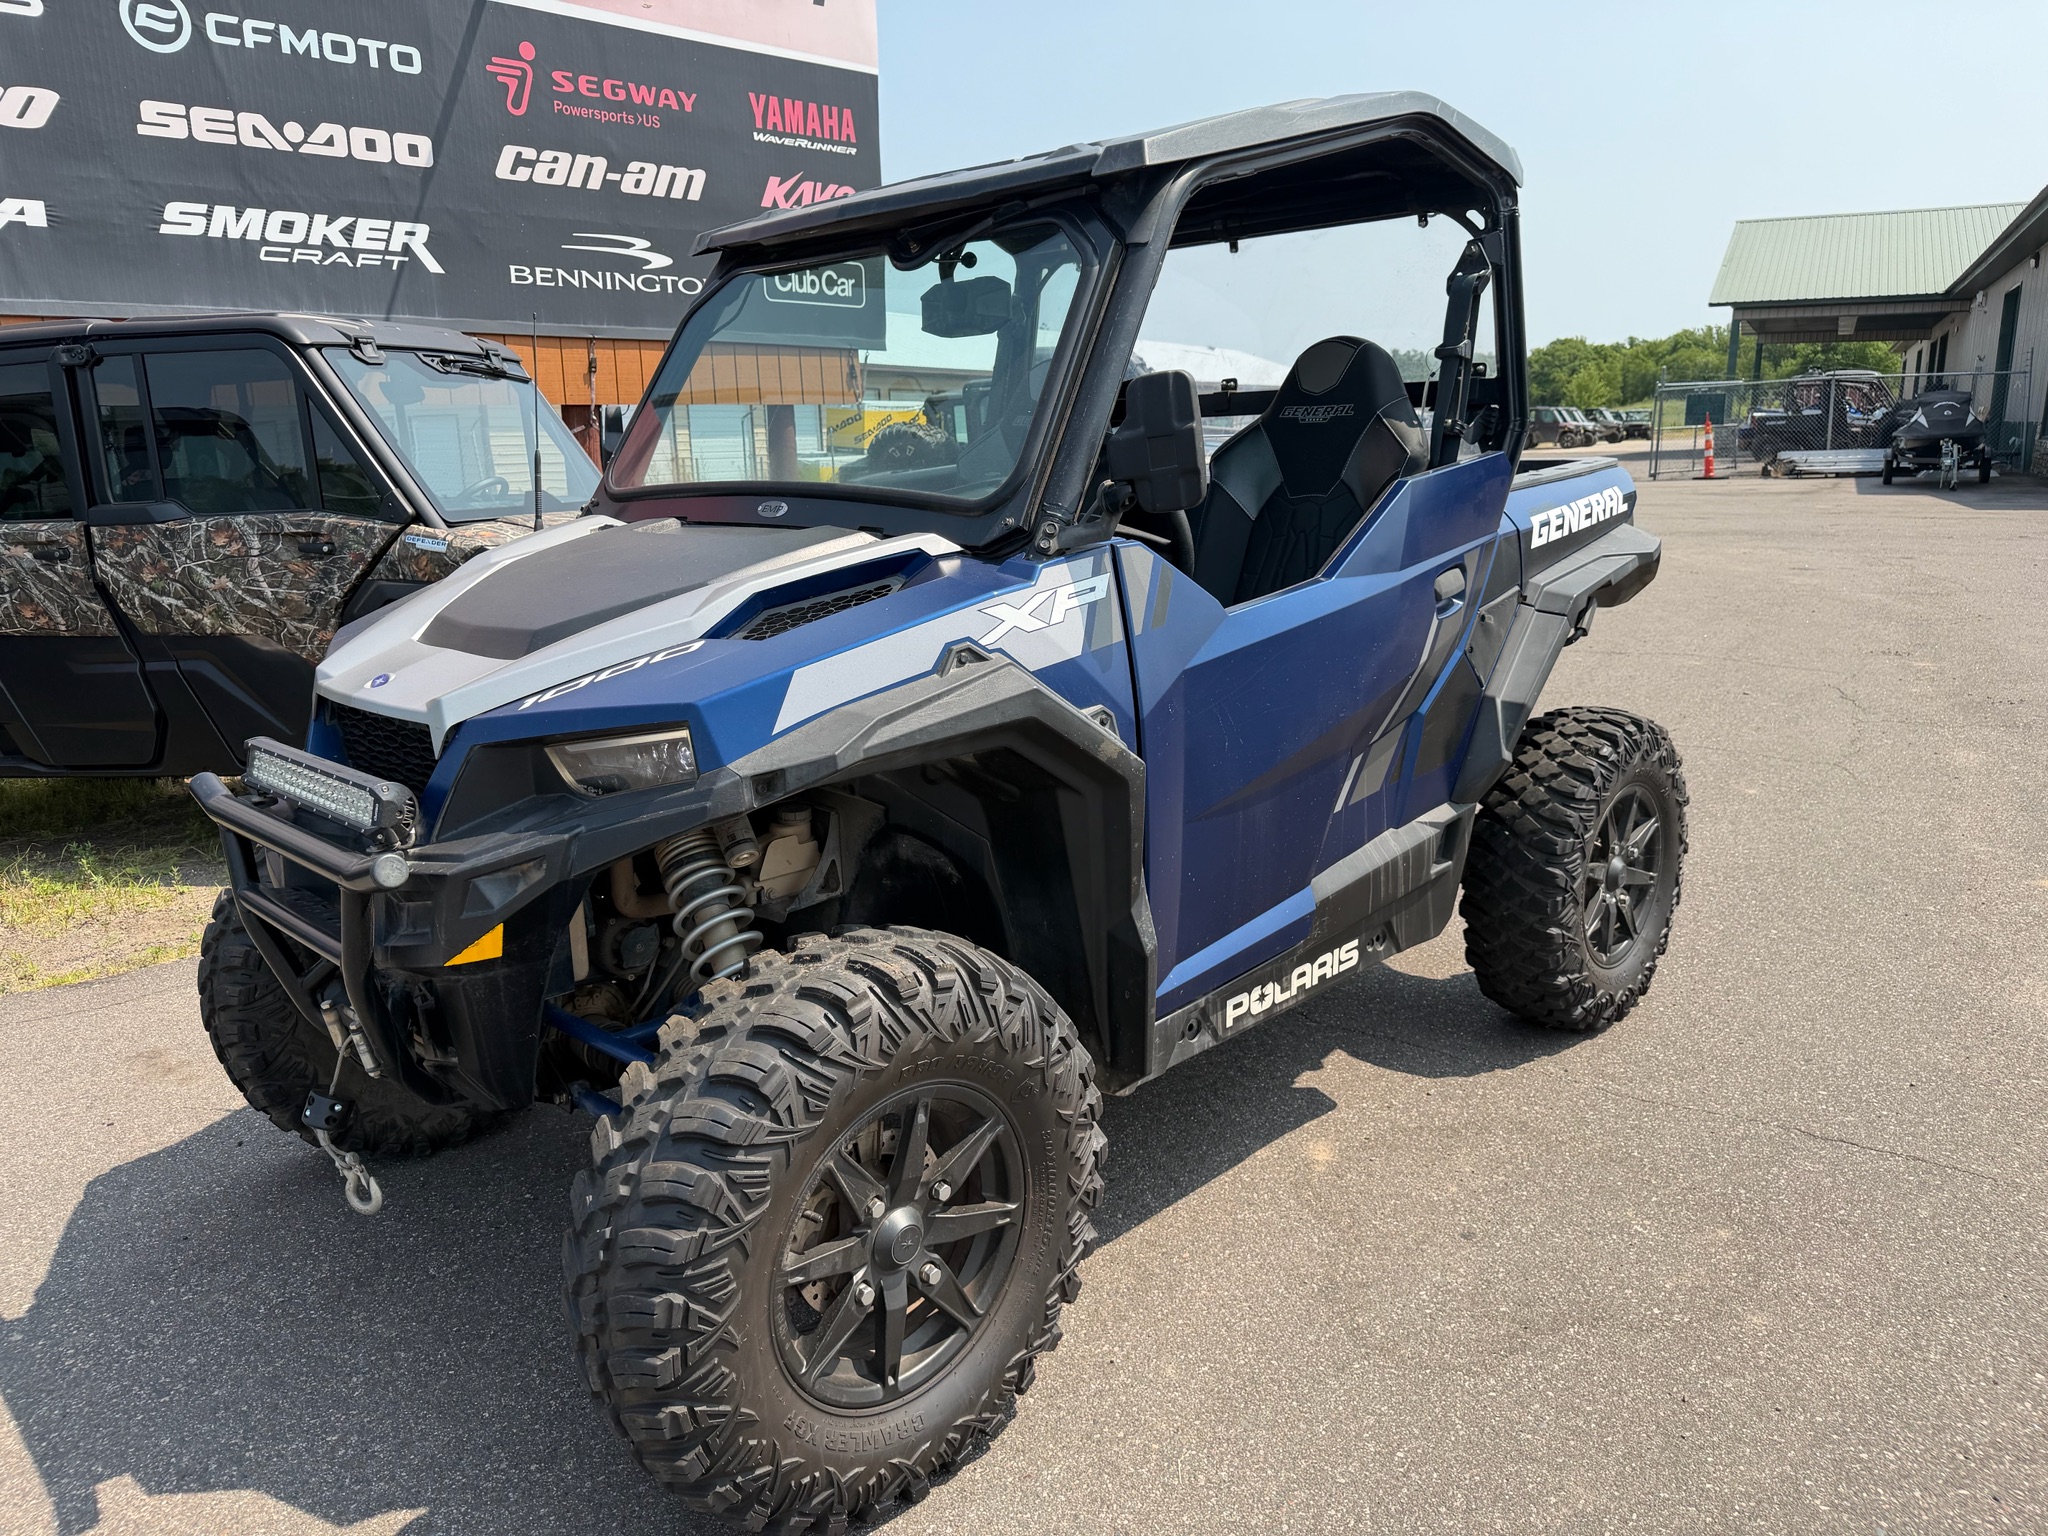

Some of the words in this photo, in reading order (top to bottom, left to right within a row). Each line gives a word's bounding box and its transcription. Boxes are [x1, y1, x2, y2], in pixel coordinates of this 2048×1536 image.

[204, 12, 423, 75] CFMOTO
[551, 70, 698, 113] SEGWAY
[748, 92, 857, 144] YAMAHA
[495, 144, 707, 201] can-am
[158, 201, 446, 274] SMOKER
[259, 245, 409, 271] CRAFT
[508, 265, 707, 296] BENNINGTO
[774, 269, 820, 295] Club
[821, 264, 856, 297] Car
[1279, 403, 1355, 418] GENERAL
[761, 504, 784, 513] EMP
[1529, 485, 1629, 549] GENERAL
[406, 535, 447, 547] DEFENDER
[976, 572, 1111, 647] XP
[517, 639, 706, 712] 1000
[1225, 938, 1360, 1029] POLARIS
[824, 1410, 926, 1452] CRAWLER
